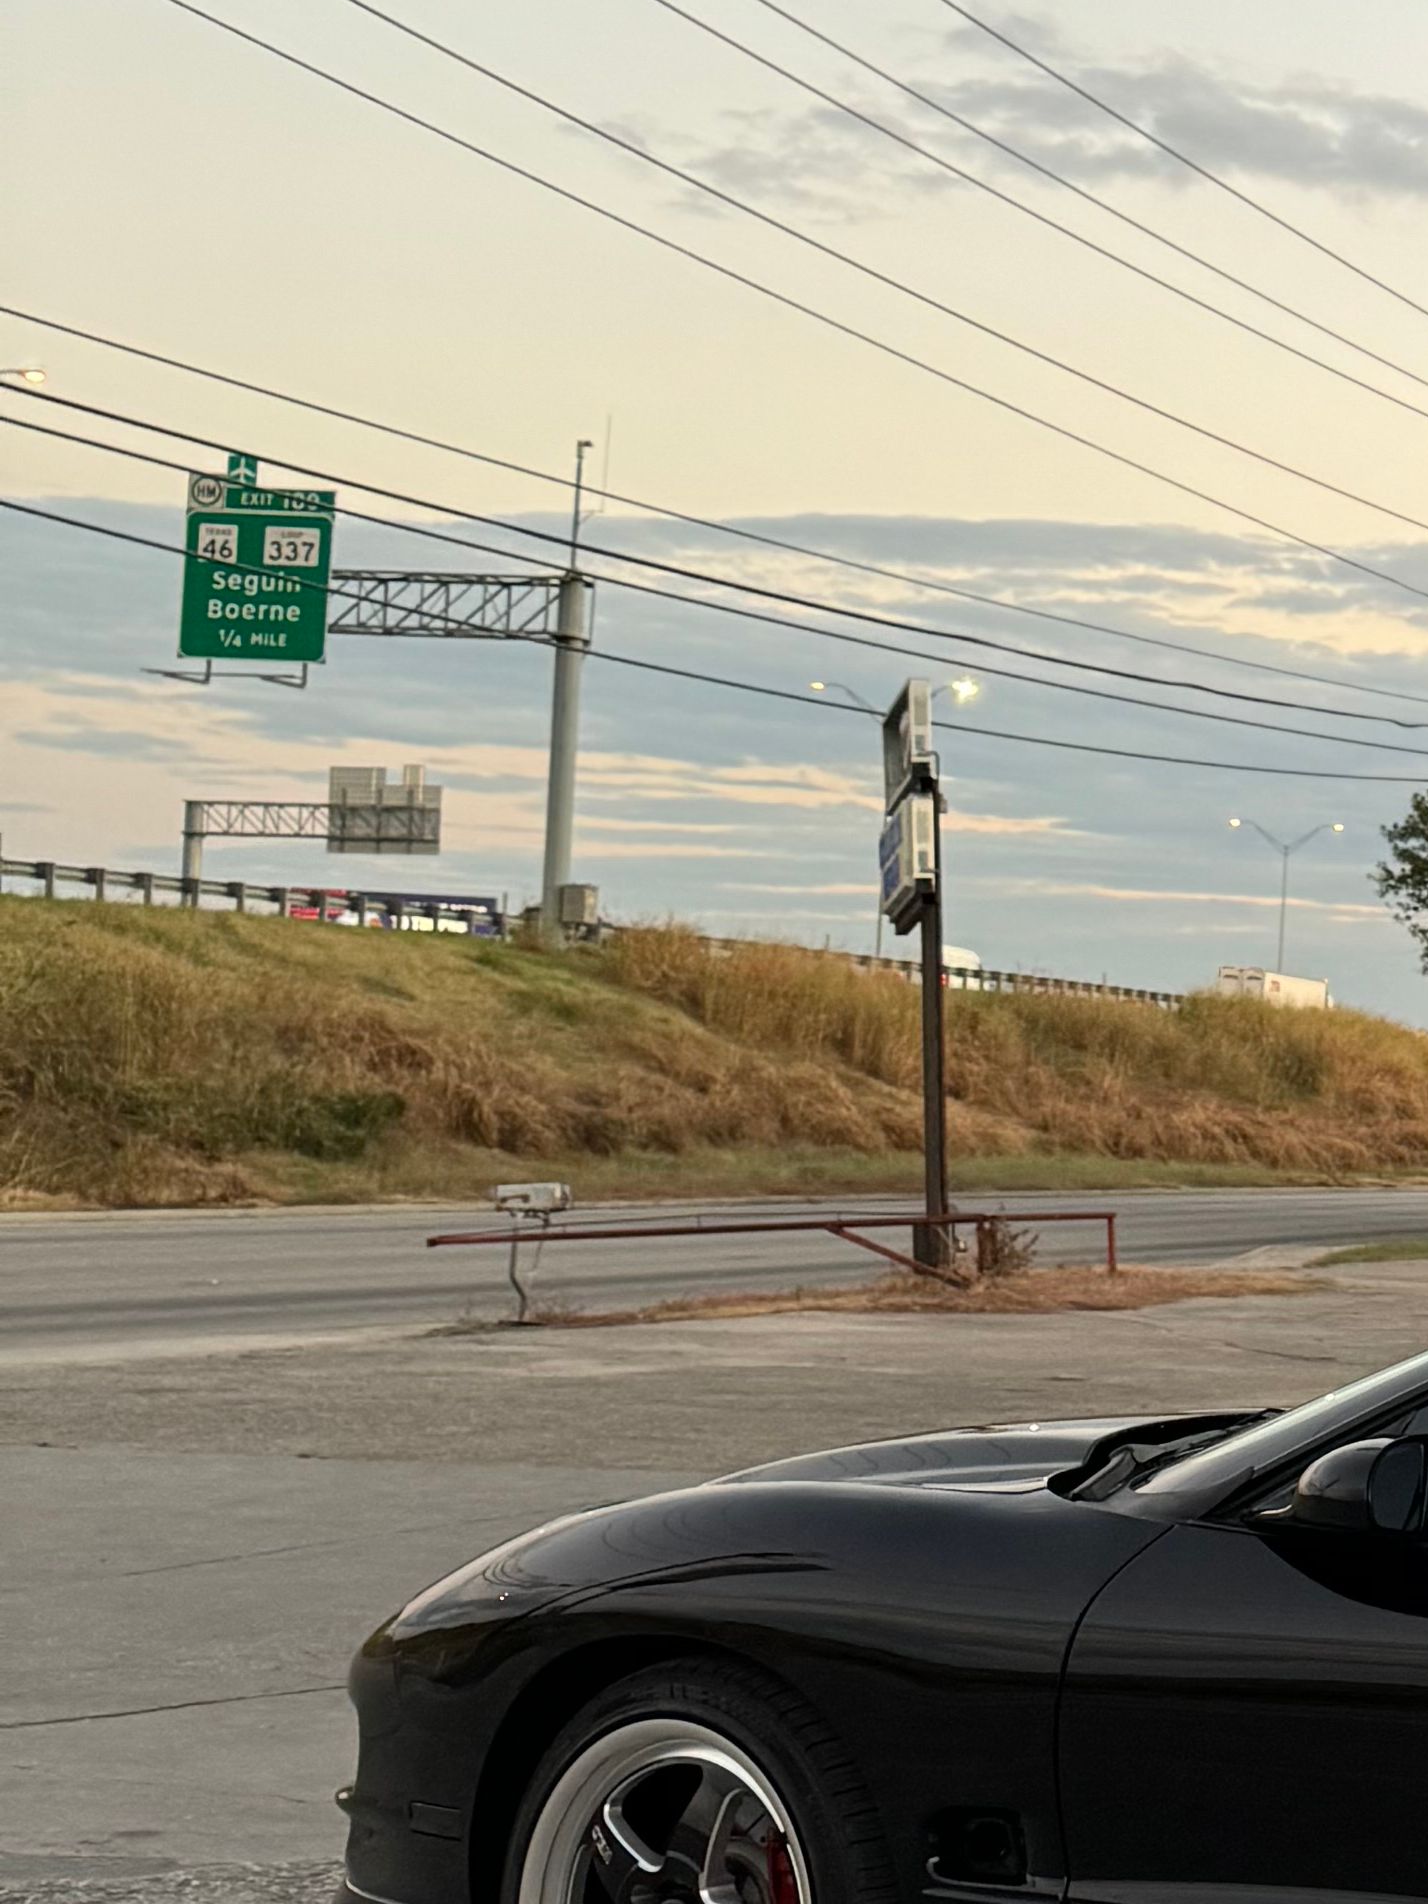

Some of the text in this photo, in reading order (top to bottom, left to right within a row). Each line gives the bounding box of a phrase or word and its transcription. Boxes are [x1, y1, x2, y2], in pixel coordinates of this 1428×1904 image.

[240, 492, 274, 507] EXIT
[202, 539, 233, 559] 46
[268, 540, 315, 562] 337
[211, 571, 302, 596] Seguin
[207, 598, 301, 622] Boerne
[250, 632, 287, 647] MILE
